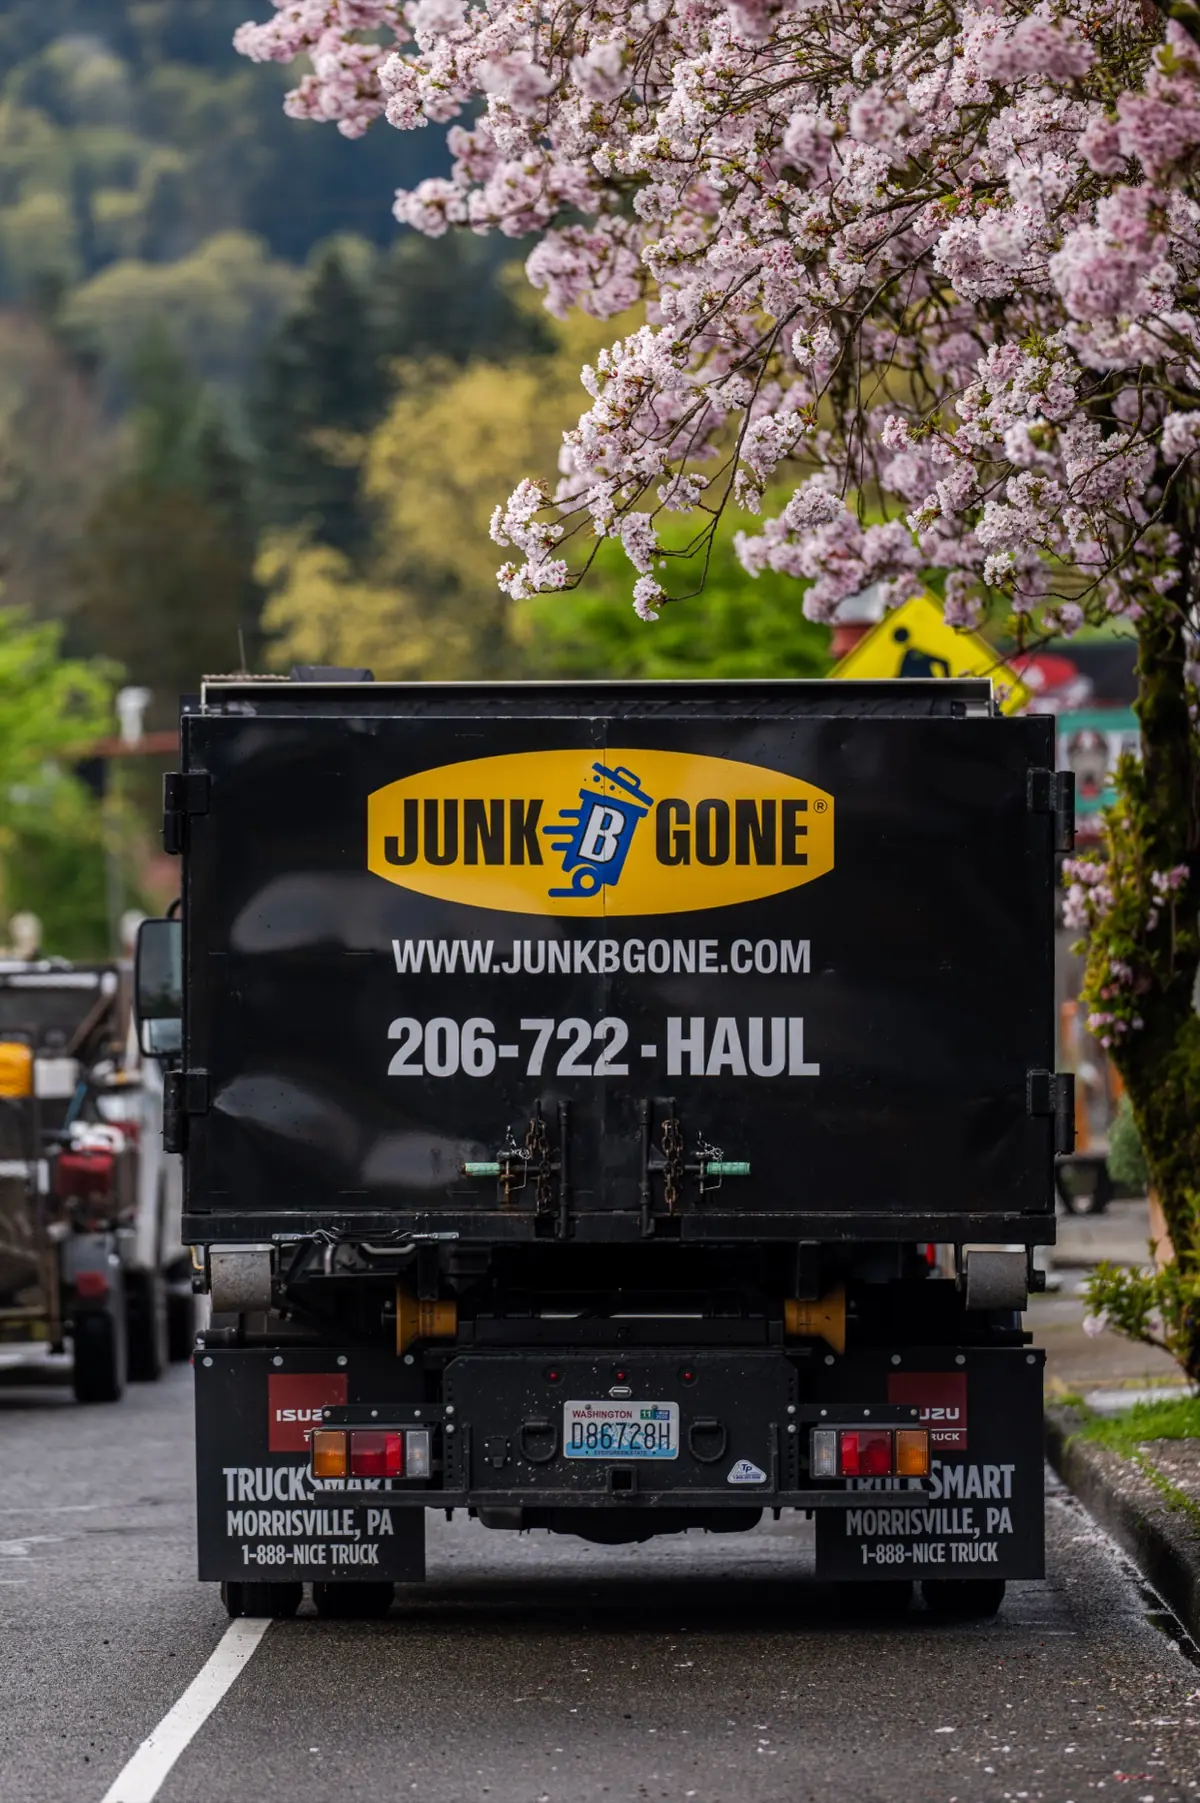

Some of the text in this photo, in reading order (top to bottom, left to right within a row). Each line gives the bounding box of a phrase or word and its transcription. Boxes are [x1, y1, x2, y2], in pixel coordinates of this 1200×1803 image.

[384, 798, 544, 866] JUNK
[576, 802, 625, 864] B
[655, 798, 809, 867] GONE
[392, 939, 811, 974] WWW.JUNKBGONE.COM
[276, 1409, 323, 1421] ISUZ
[572, 1410, 633, 1419] WASHINGTON
[919, 1408, 960, 1420] UZU
[571, 1422, 670, 1450] D86728H
[931, 1432, 960, 1441] RUCK
[227, 1508, 394, 1541] MORRISVILLE, PA
[846, 1507, 1013, 1539] MORRISVILLE, PA
[241, 1543, 379, 1565] 1-888-NICE TRUCK
[861, 1541, 998, 1564] 1-888-NICE TRUCK
